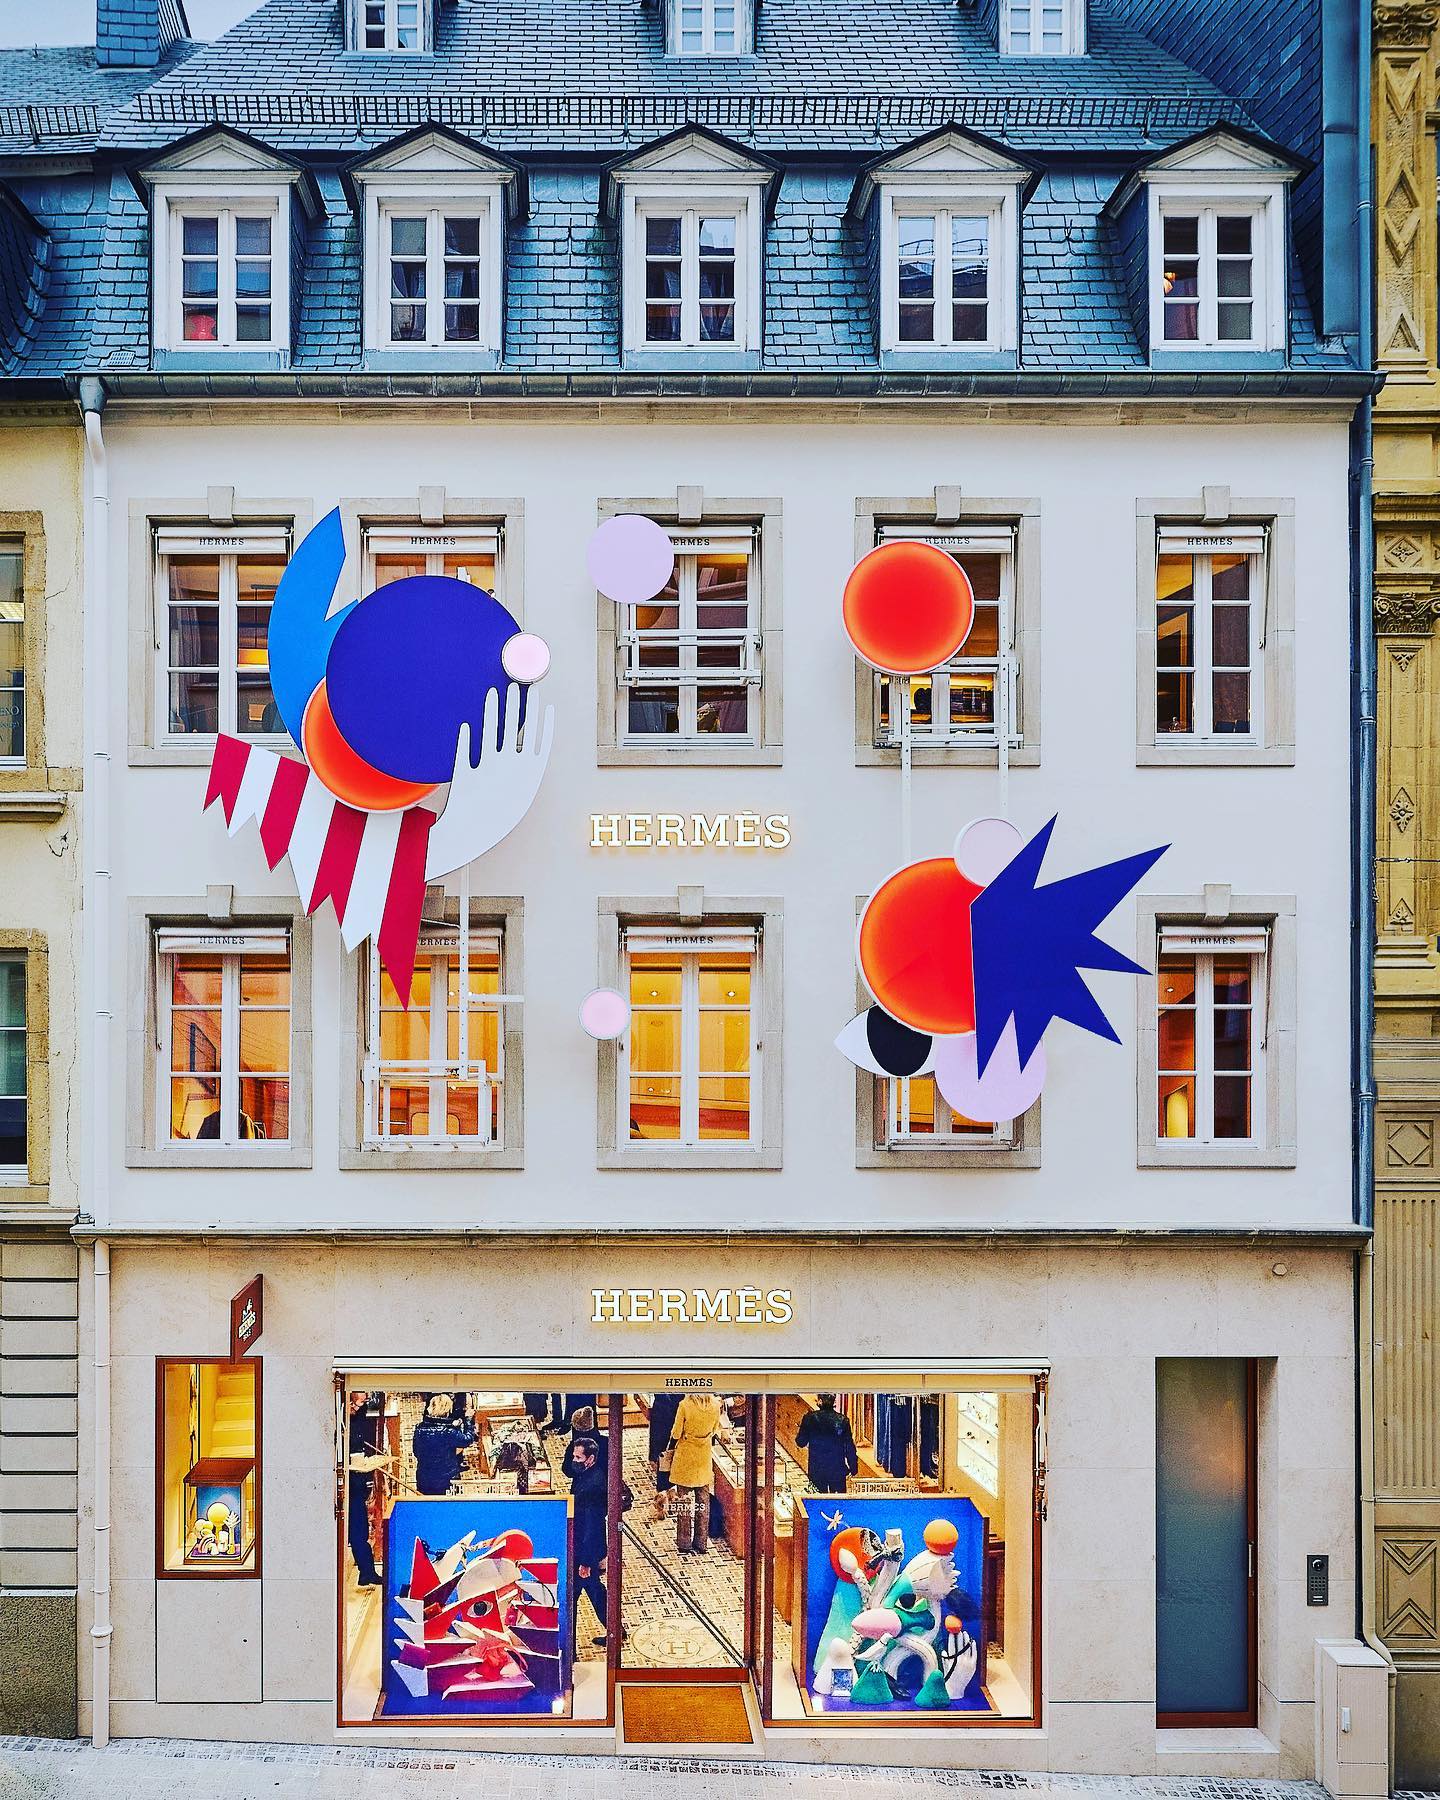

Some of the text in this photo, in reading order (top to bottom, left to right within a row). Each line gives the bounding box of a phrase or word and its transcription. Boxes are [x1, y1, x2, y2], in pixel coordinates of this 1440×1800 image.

[673, 538, 710, 546] ERMES
[589, 810, 791, 849] HERMÈS
[591, 1285, 793, 1324] HERMÈS
[665, 1377, 713, 1387] HERMÈS
